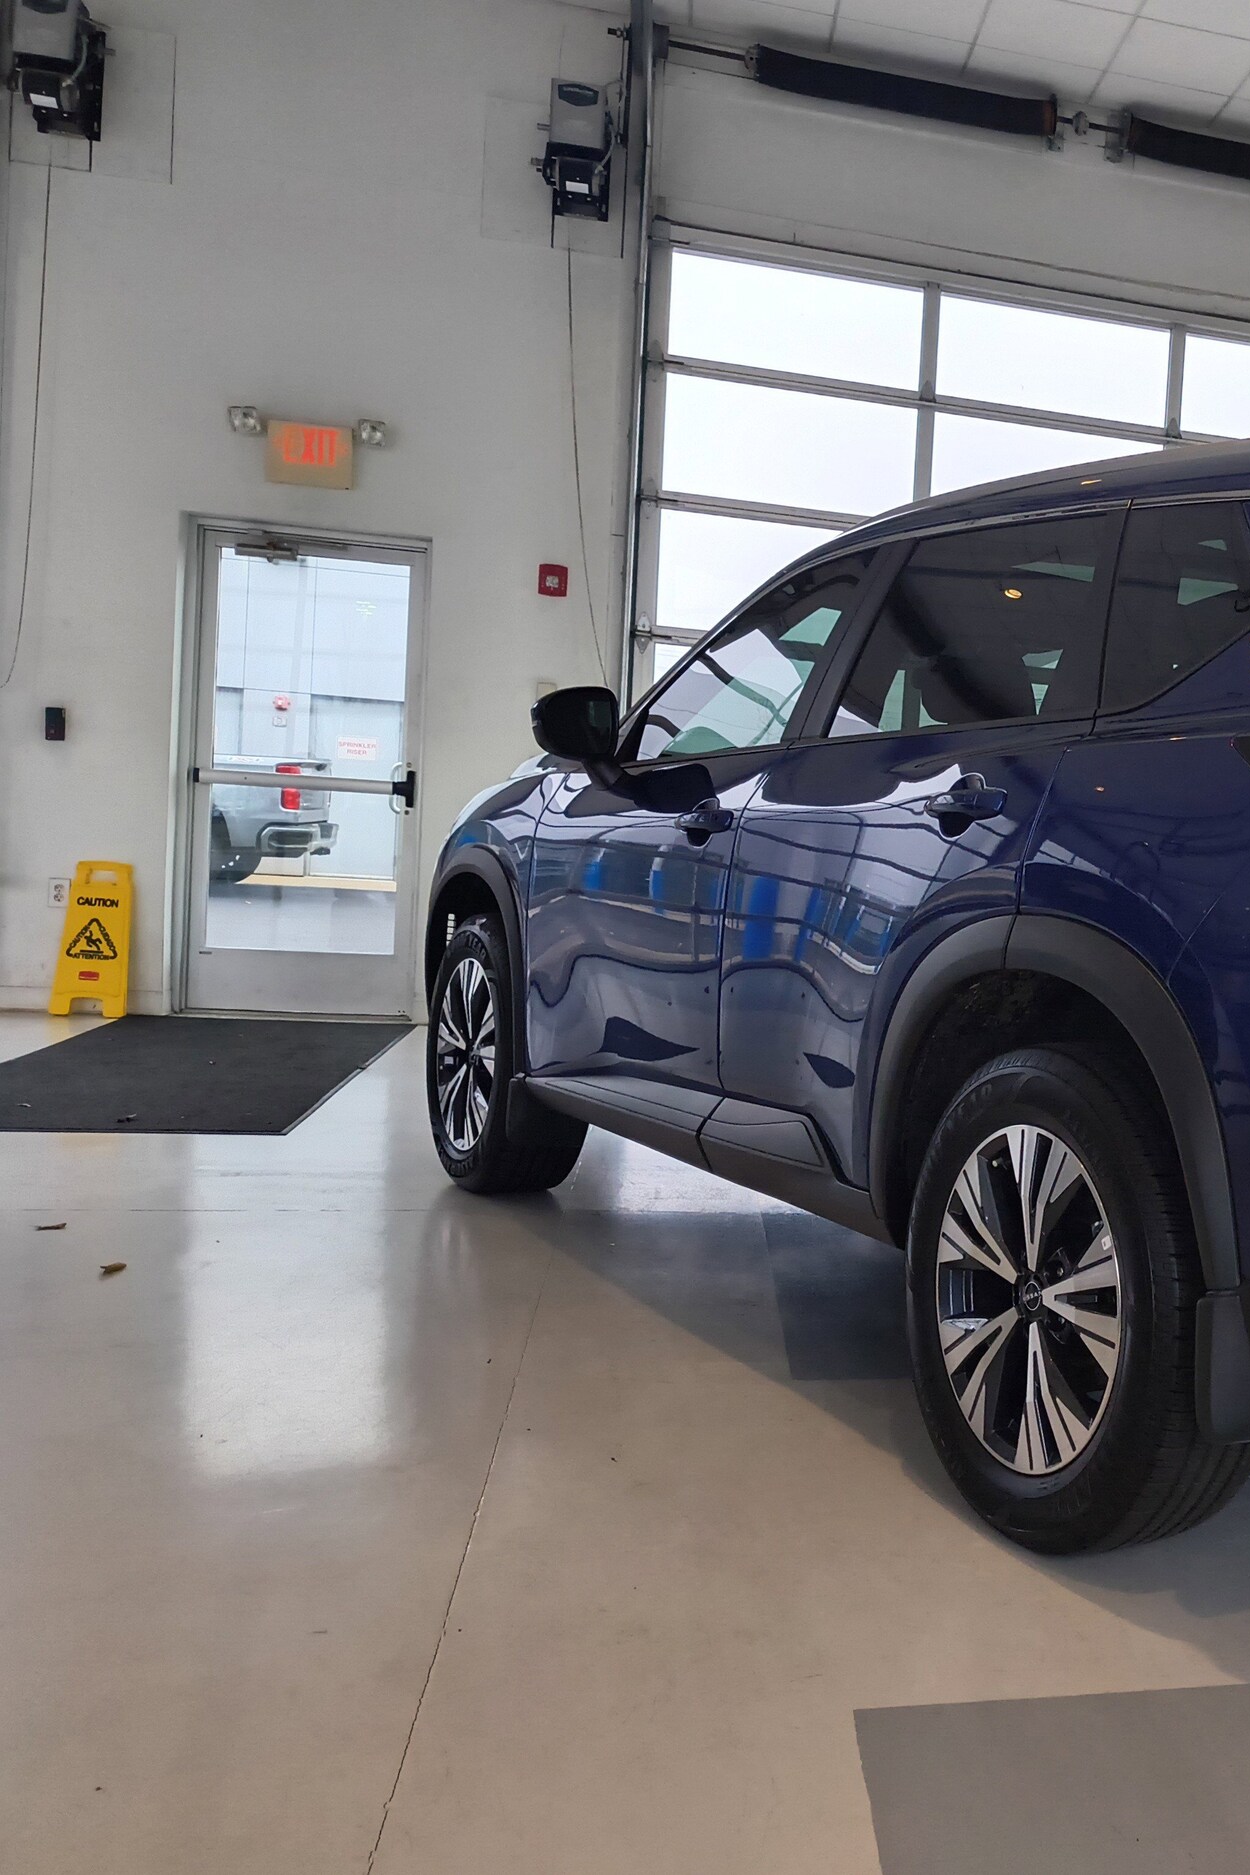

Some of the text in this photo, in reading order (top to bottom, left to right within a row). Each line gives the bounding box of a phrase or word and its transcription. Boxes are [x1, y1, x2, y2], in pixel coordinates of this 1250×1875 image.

[283, 424, 338, 466] EXIT
[338, 741, 377, 749] SPRINKLER
[76, 896, 119, 908] CAUTION
